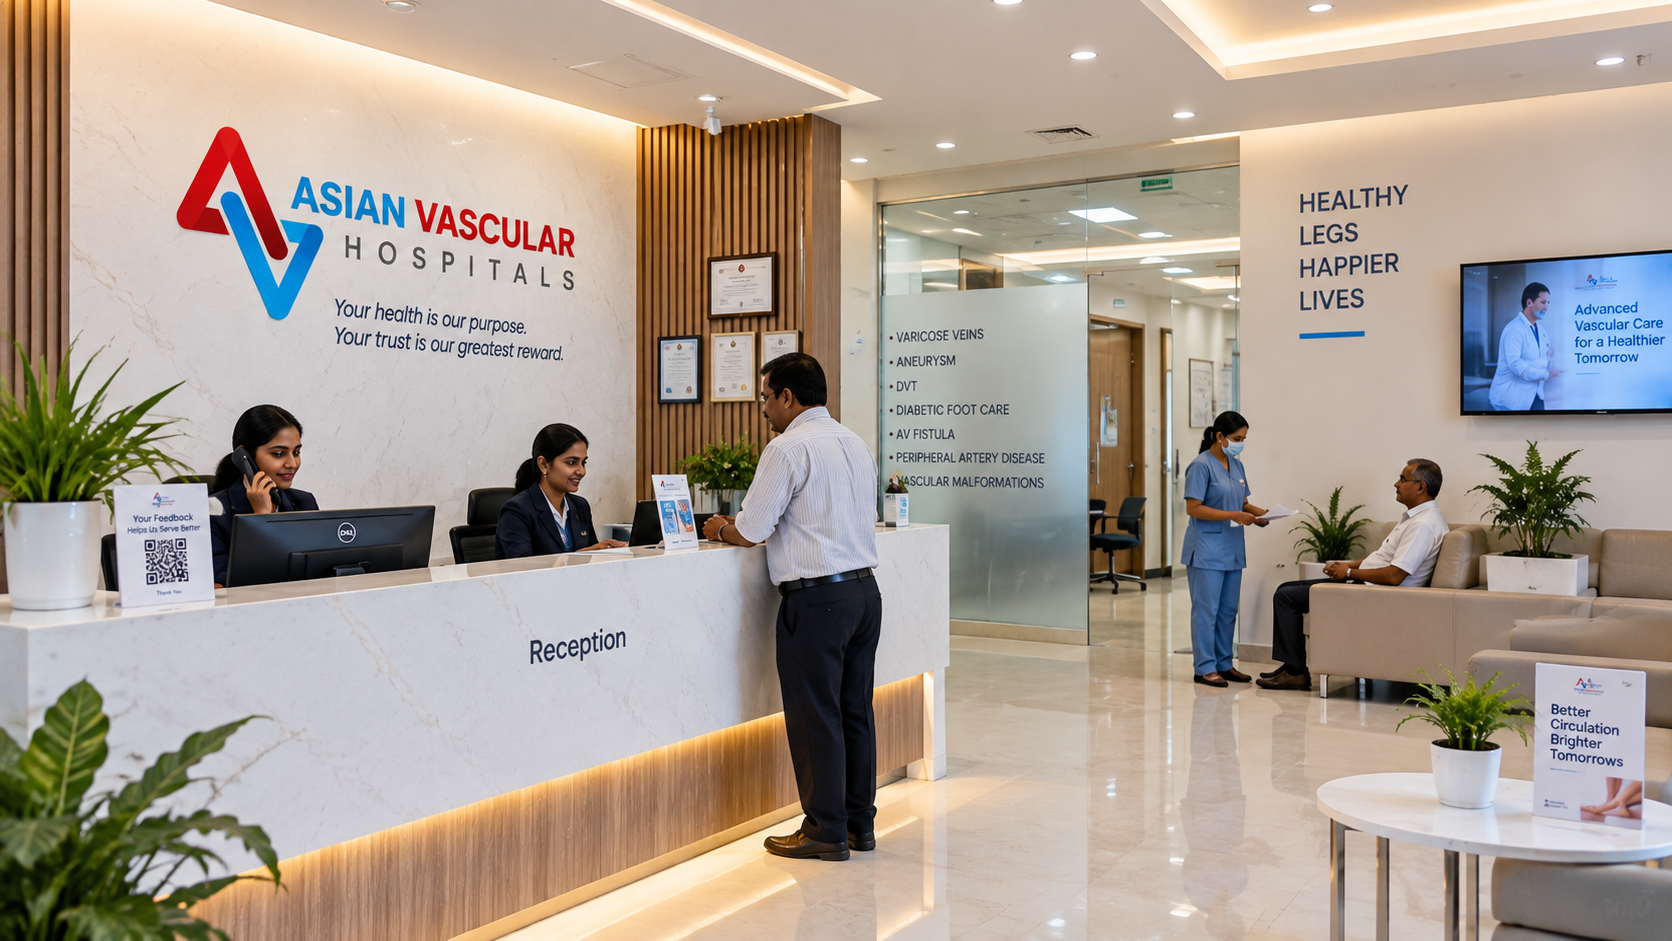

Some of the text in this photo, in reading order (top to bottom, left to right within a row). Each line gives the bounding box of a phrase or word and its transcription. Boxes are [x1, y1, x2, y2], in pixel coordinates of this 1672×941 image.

[1300, 184, 1409, 213] HEALTHY
[291, 176, 575, 258] ASIAN VASCULAR
[1300, 222, 1359, 246] LEGS
[345, 235, 575, 291] HOSPITALS
[1300, 252, 1399, 278] HAPPIER
[1300, 288, 1365, 311] LIVES
[1574, 301, 1638, 316] Advanced
[335, 299, 527, 336] Your health is our purpose.
[1575, 318, 1664, 332] Vascular Care
[896, 328, 984, 343] VARICOSE VEINS
[1574, 334, 1666, 349] for a Healthier
[335, 326, 564, 361] Your trust is our greatest reward.
[896, 355, 956, 367] ANEURYSM
[1574, 352, 1639, 365] Tomorrow
[896, 381, 917, 392] DVT
[896, 404, 1010, 416] DIABETIC FOOT CARE
[896, 428, 956, 440] AV FISTULA
[896, 452, 1045, 464] PERIPHERAL ARTERY DISEASE
[901, 475, 1045, 489] ASCULAR MALFORMATIONS
[132, 514, 152, 523] Your
[127, 526, 148, 535] Helps
[159, 525, 179, 533] Serve
[181, 524, 201, 532] Better
[530, 628, 626, 664] Reception
[1551, 703, 1591, 718] Better
[1550, 718, 1620, 736] Circulation
[1550, 733, 1602, 750] Brighter
[1550, 748, 1624, 768] Tomorrows
